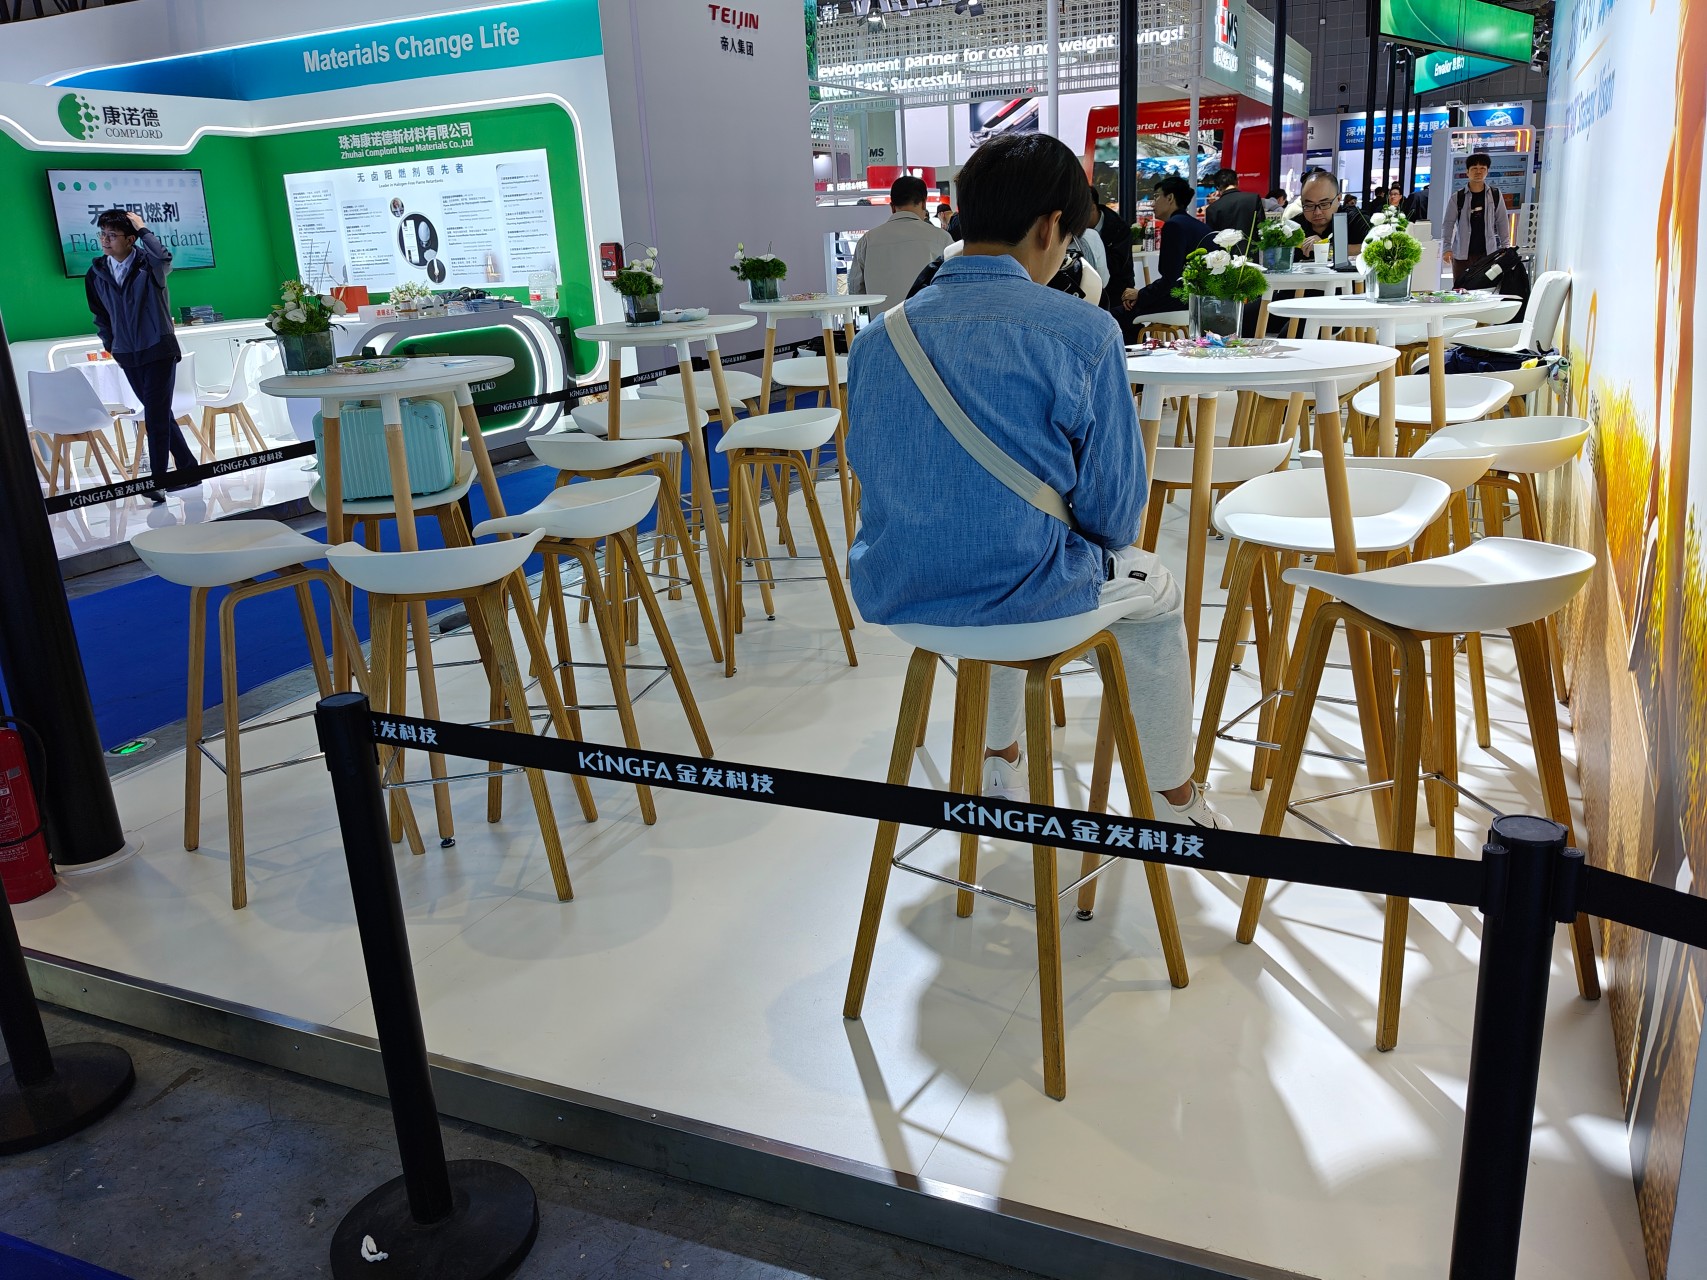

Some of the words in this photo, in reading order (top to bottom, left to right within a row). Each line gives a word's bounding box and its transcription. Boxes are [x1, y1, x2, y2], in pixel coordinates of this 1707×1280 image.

[708, 4, 759, 29] TEIJIN
[303, 40, 391, 73] Materials
[394, 33, 474, 59] Change
[479, 21, 520, 49] Life
[720, 35, 754, 57] 帝人集团
[817, 57, 900, 78] evelopment
[905, 52, 959, 71] partner
[963, 47, 985, 63] for
[988, 42, 1020, 58] cost
[1058, 34, 1115, 54] weight
[1136, 25, 1184, 46] vings!
[890, 71, 966, 91] Successful.
[102, 105, 161, 128] 康诺德
[1137, 121, 1160, 131] arter.
[1162, 119, 1181, 129] Live
[1184, 117, 1224, 128] Bghter.
[105, 127, 163, 140] COMPLORD
[338, 122, 472, 150] 珠海康诺德新材料有限公司
[340, 147, 365, 160] Zhuhai
[365, 144, 398, 158] Complord
[399, 144, 415, 154] New
[415, 140, 448, 152] Materials
[356, 163, 464, 183] 无卤阻燃剂领先者
[250, 451, 284, 466] 金发科技
[114, 479, 156, 498] 金发科技
[676, 762, 775, 794] 金发科技
[1071, 818, 1205, 859] 金发科技
